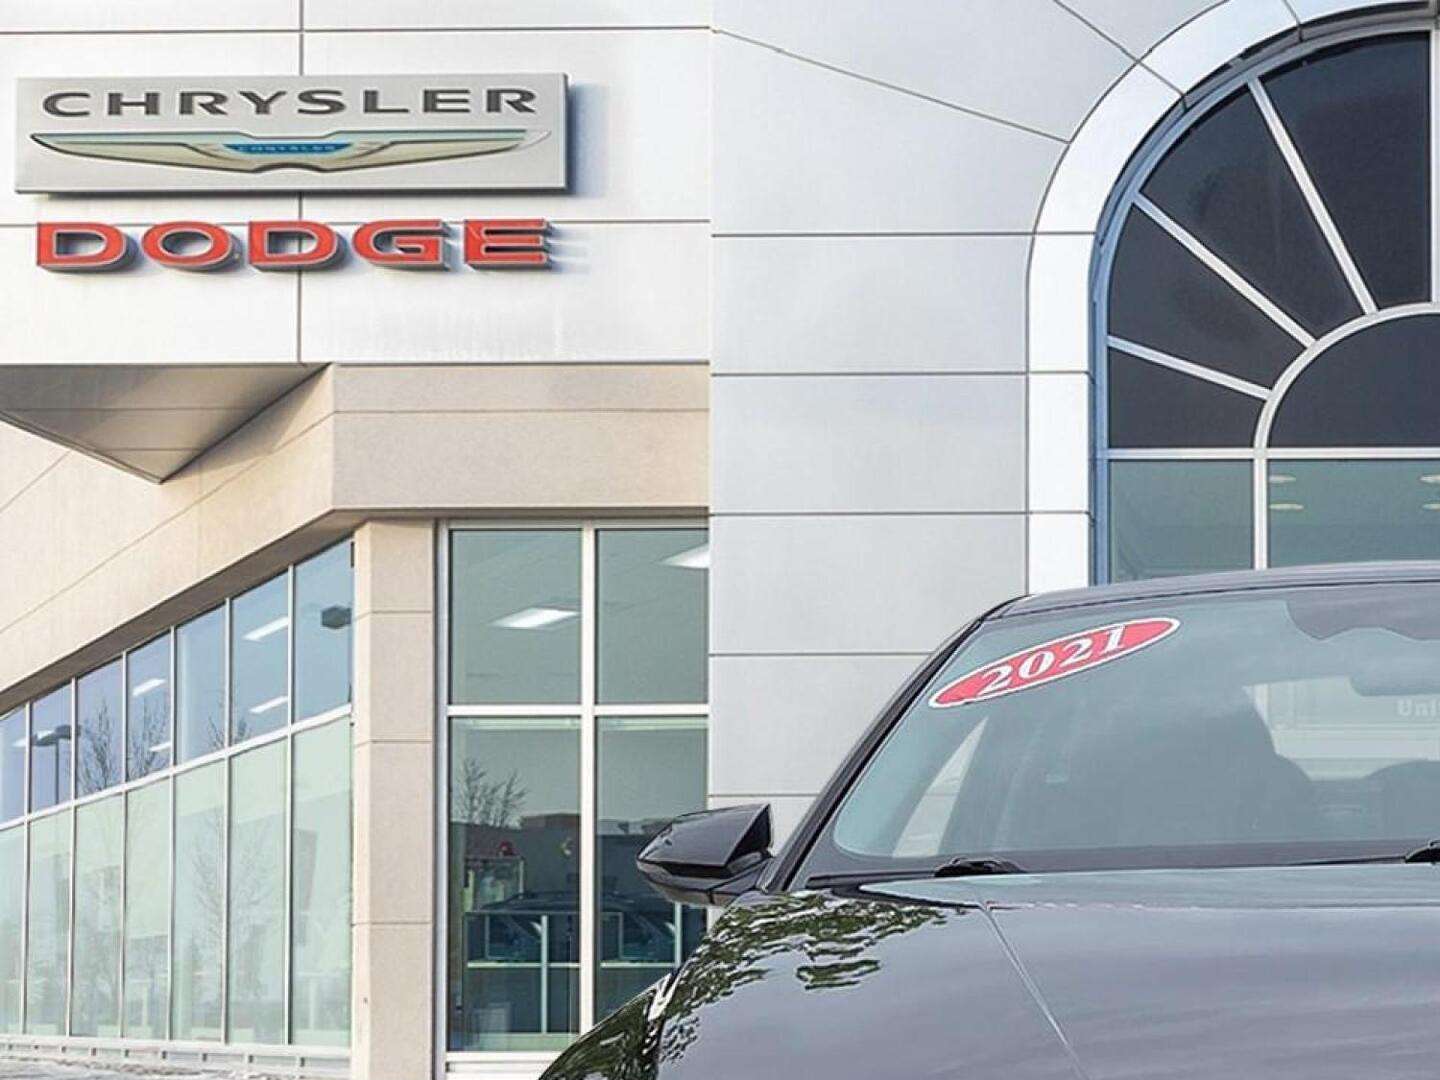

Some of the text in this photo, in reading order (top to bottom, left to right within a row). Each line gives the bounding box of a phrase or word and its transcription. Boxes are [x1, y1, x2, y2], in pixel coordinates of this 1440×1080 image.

[43, 88, 536, 117] CHRYSLER
[36, 219, 553, 272] DODGE
[976, 624, 1127, 696] 2021
